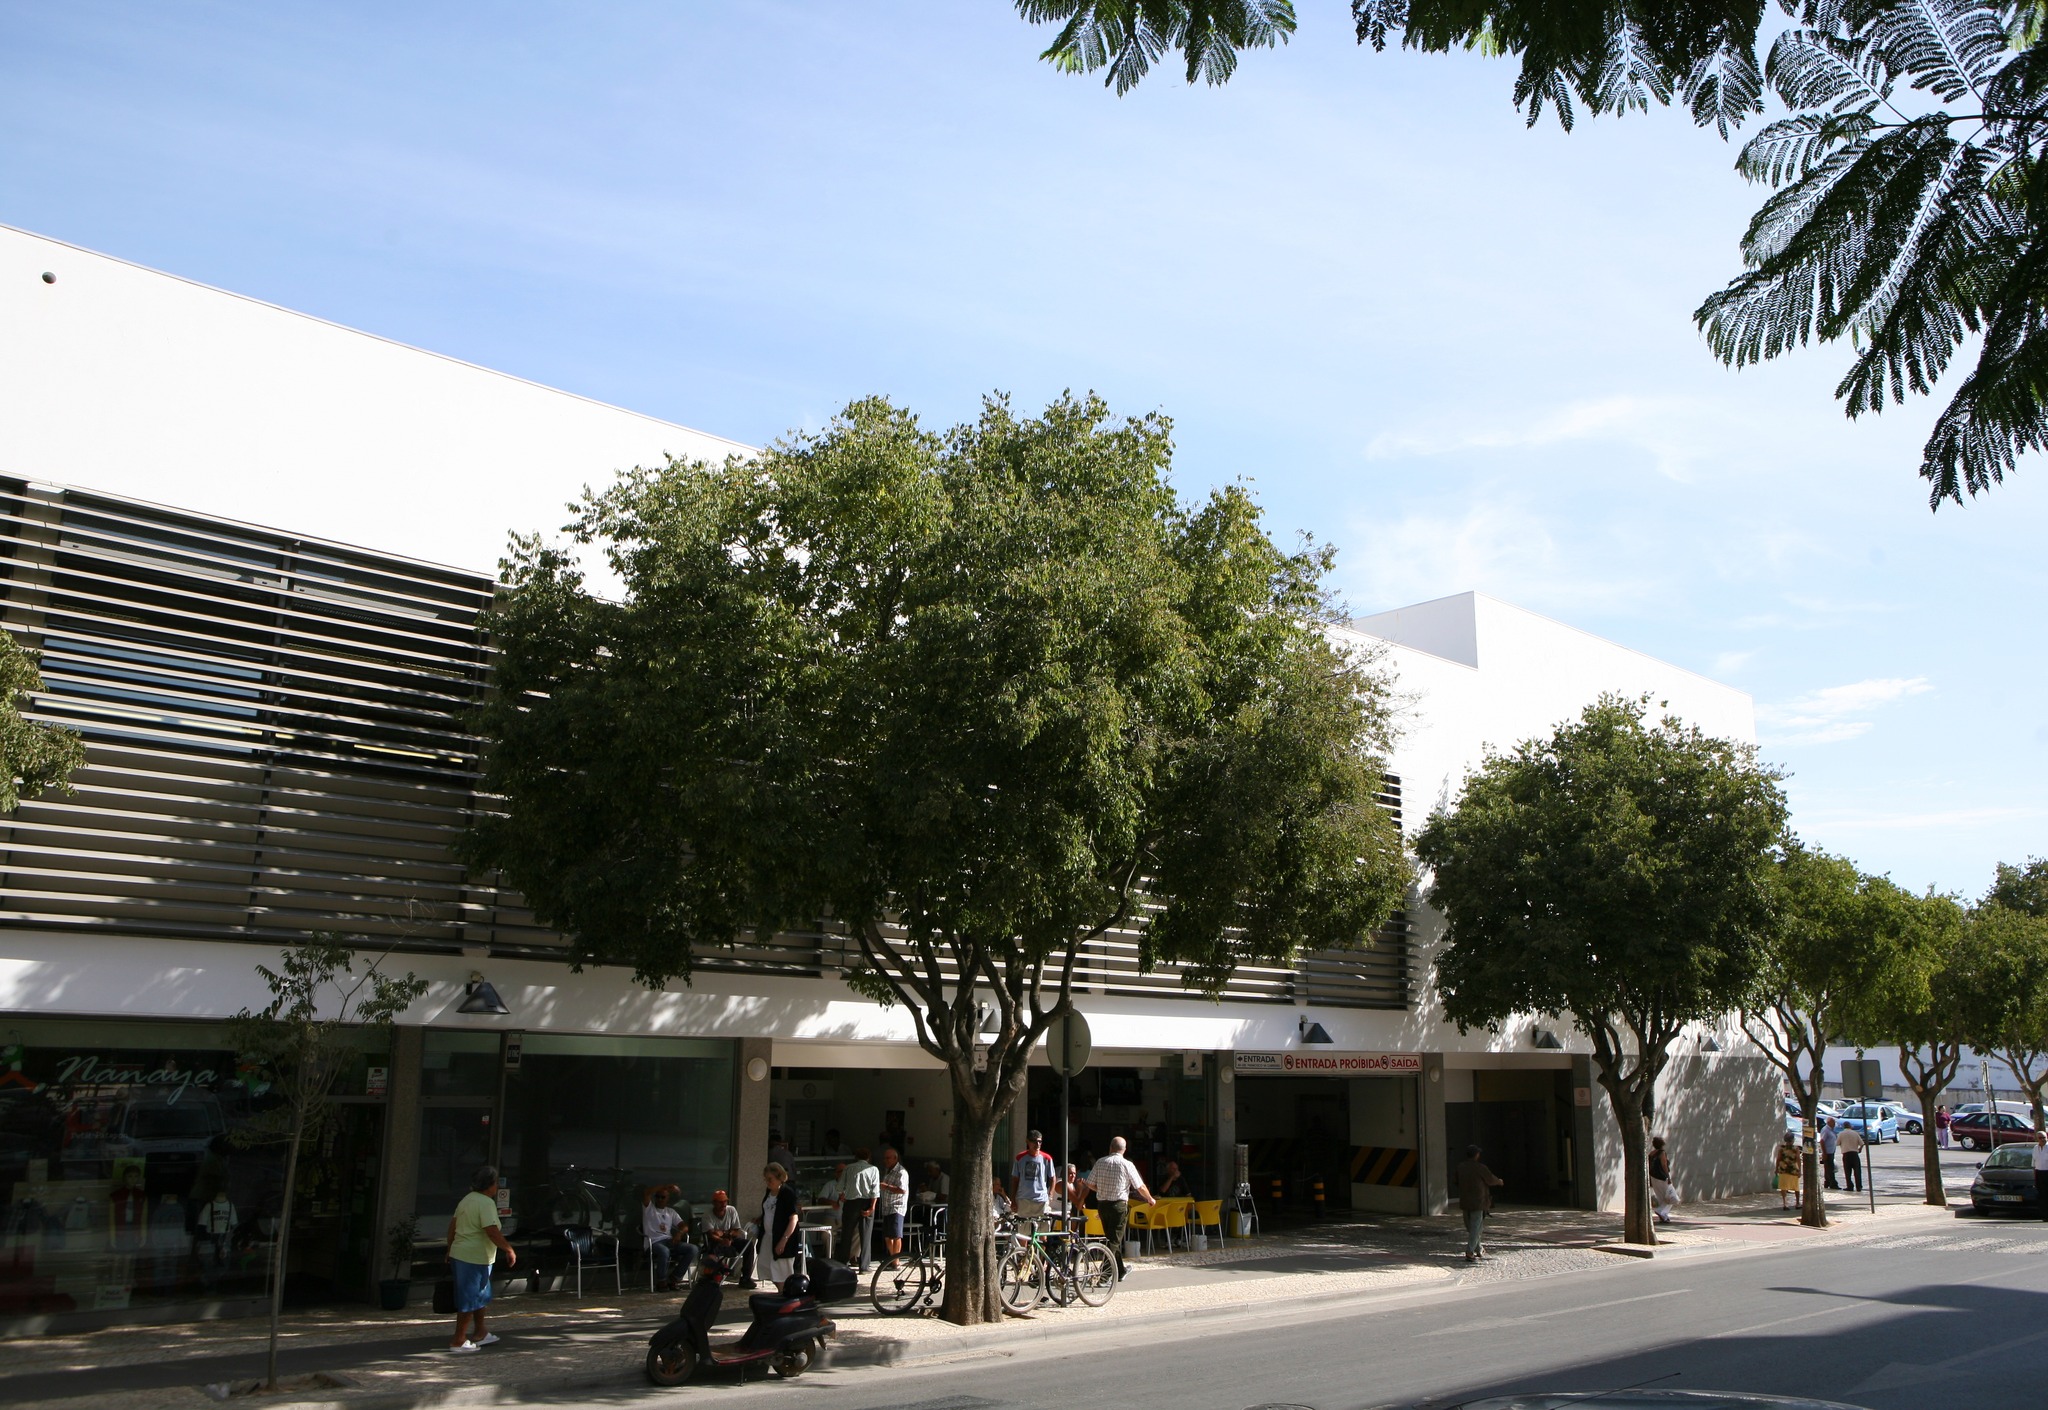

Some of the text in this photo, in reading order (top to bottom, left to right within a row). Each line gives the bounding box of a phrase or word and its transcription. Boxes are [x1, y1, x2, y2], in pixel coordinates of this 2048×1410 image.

[1243, 1055, 1276, 1063] ENTRADA
[1295, 1058, 1338, 1069] ENTRADA
[1340, 1056, 1381, 1069] PROÍBIDA
[1391, 1057, 1419, 1068] SAÍDA
[56, 1055, 219, 1105] Nanaya
